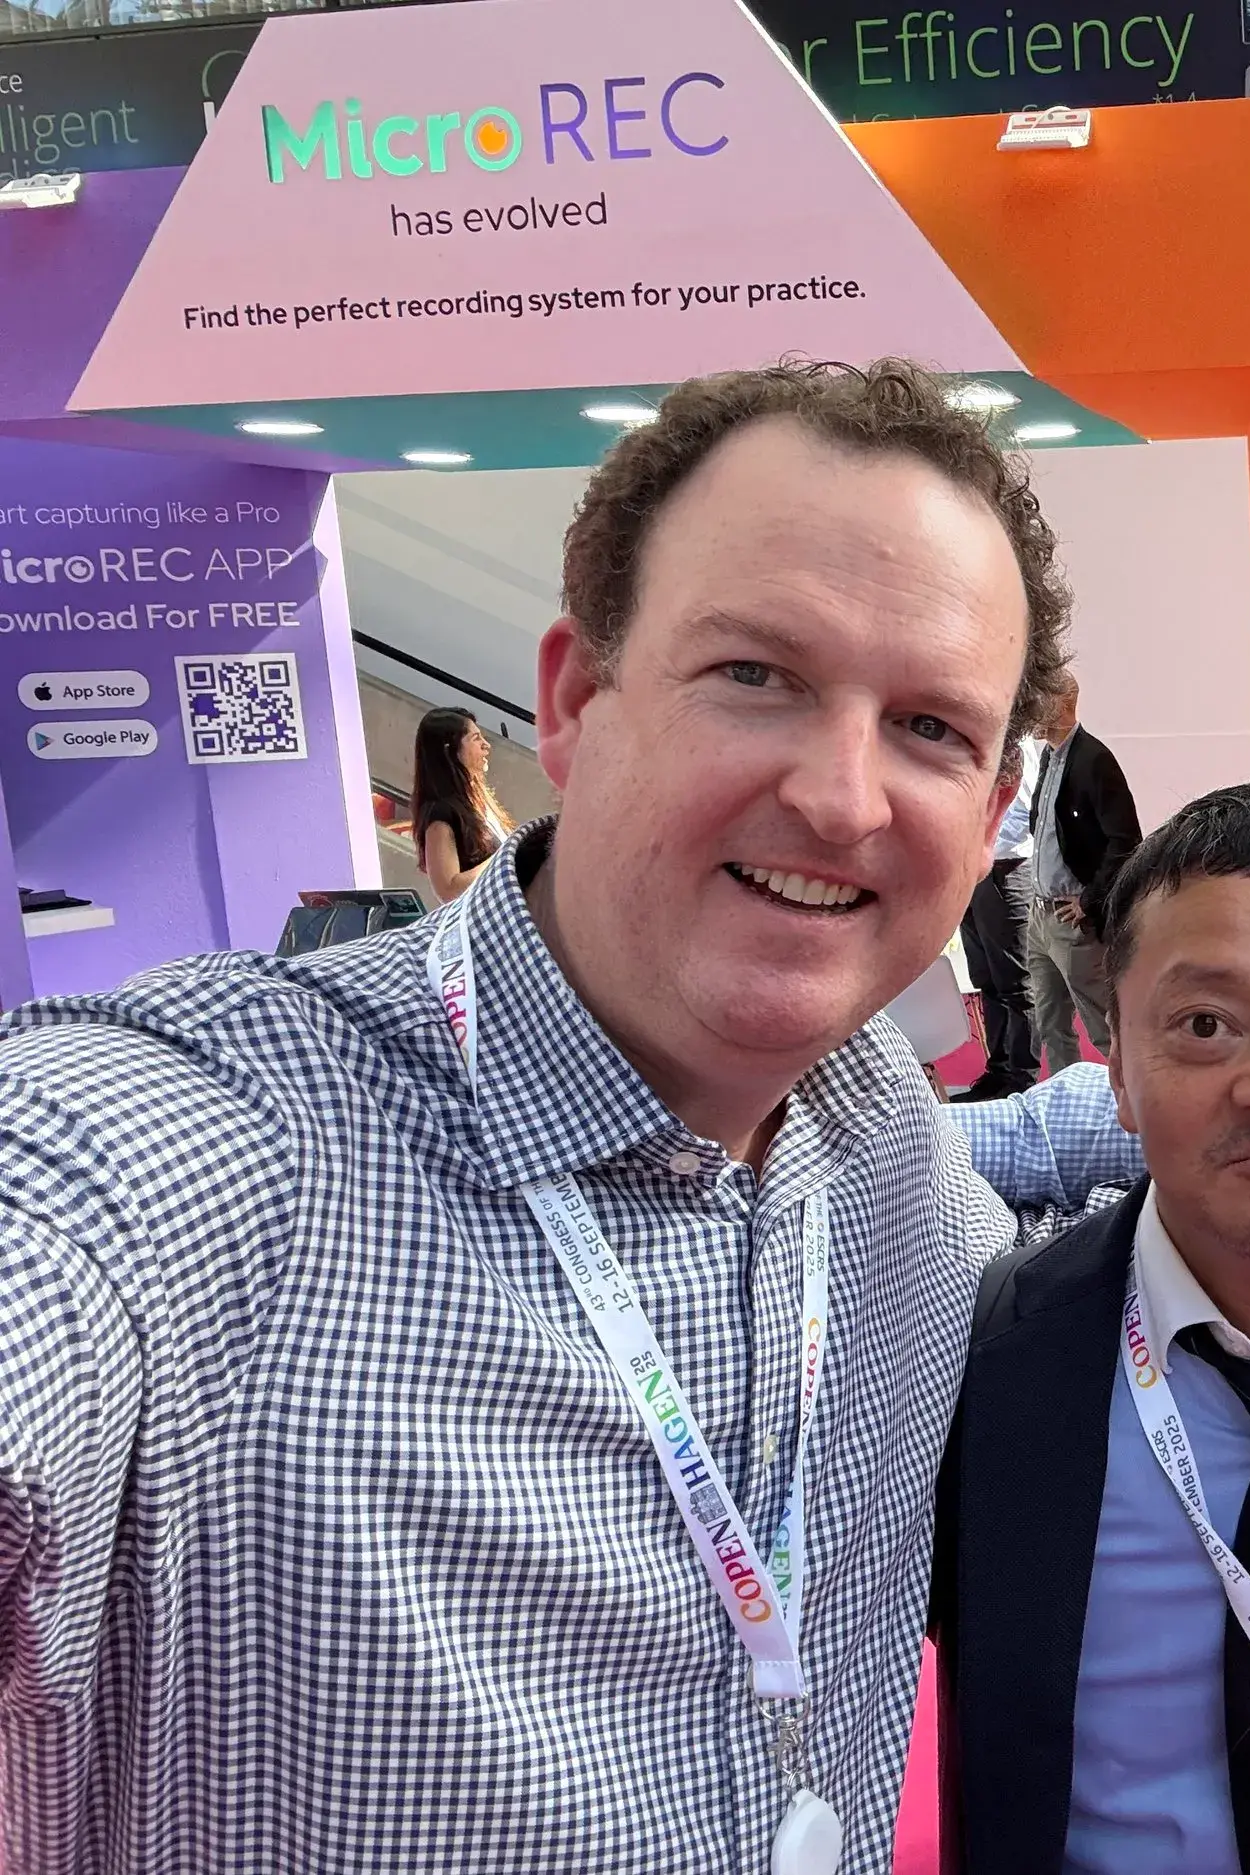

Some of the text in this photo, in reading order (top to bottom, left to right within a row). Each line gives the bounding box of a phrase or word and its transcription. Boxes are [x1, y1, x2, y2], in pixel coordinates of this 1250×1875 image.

[855, 9, 1195, 88] Efficiency
[390, 192, 608, 237] has evolved
[184, 274, 866, 330] Find the perfect recording system for your practice.
[35, 503, 160, 529] capturing
[167, 502, 208, 525] like
[215, 508, 230, 525] a
[237, 502, 280, 524] Pro
[204, 548, 293, 581] APP
[146, 604, 199, 629] For
[208, 601, 301, 628] FREE
[62, 684, 135, 700] App Store
[63, 730, 150, 748] Google Play
[540, 1196, 553, 1213] OF
[546, 1210, 594, 1285] CONGRESS
[806, 1233, 815, 1277] 2025
[816, 1234, 826, 1273] ESCRS
[596, 1258, 634, 1314] 12-16
[1152, 1429, 1170, 1464] ESCRS
[1163, 1414, 1187, 1453] 2025
[1212, 1545, 1246, 1585] 12-16
